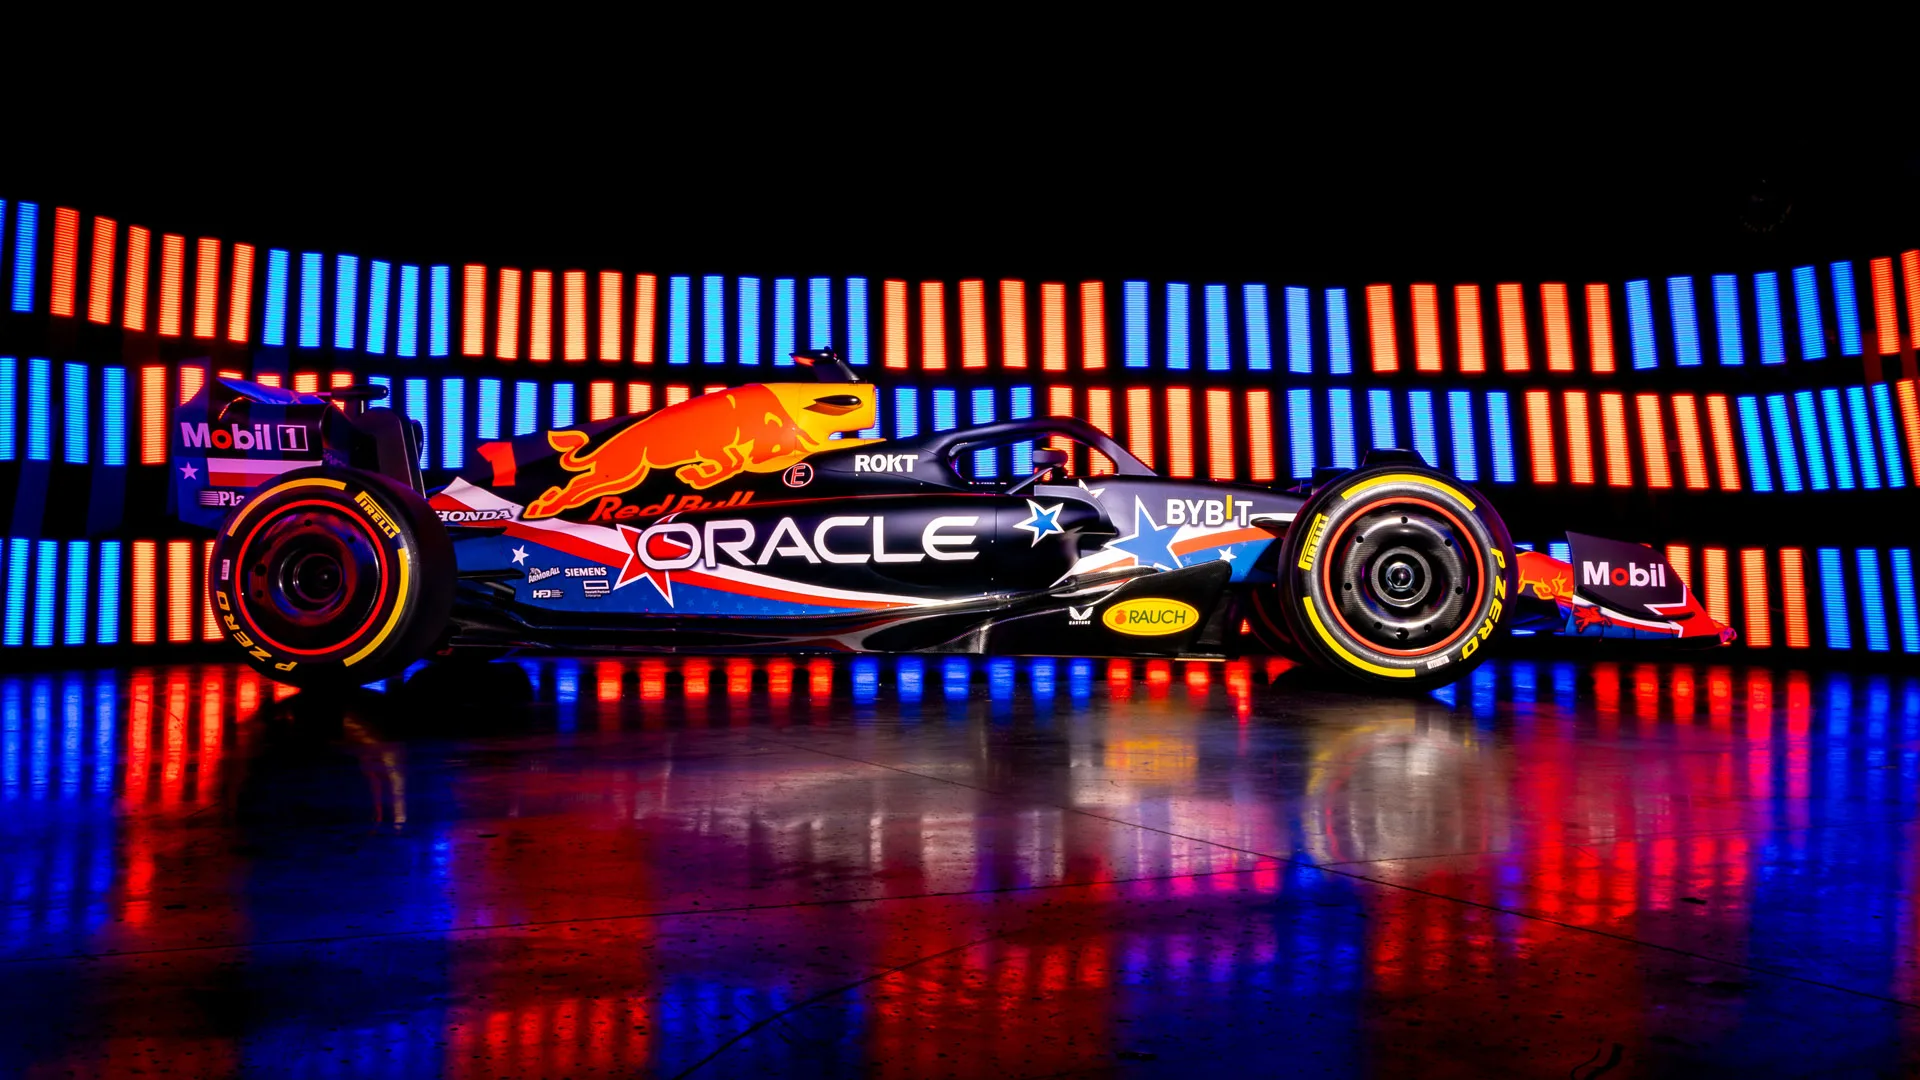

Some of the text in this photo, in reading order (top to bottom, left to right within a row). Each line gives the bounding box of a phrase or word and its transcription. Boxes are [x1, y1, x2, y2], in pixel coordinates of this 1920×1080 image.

[180, 422, 272, 451] Mobil
[854, 454, 918, 473] ROKT
[354, 490, 401, 539] PIRELLI
[435, 510, 512, 522] HONDA
[588, 494, 676, 521] Red
[1166, 494, 1253, 526] BYBIT
[637, 515, 980, 570] ORACLE
[1298, 513, 1330, 571] PIRELLI
[564, 567, 607, 577] SIEMENS
[1582, 560, 1666, 587] Mobil
[216, 590, 273, 663] ZERO
[1128, 610, 1186, 624] RAUCH
[1461, 575, 1507, 660] ZERO
